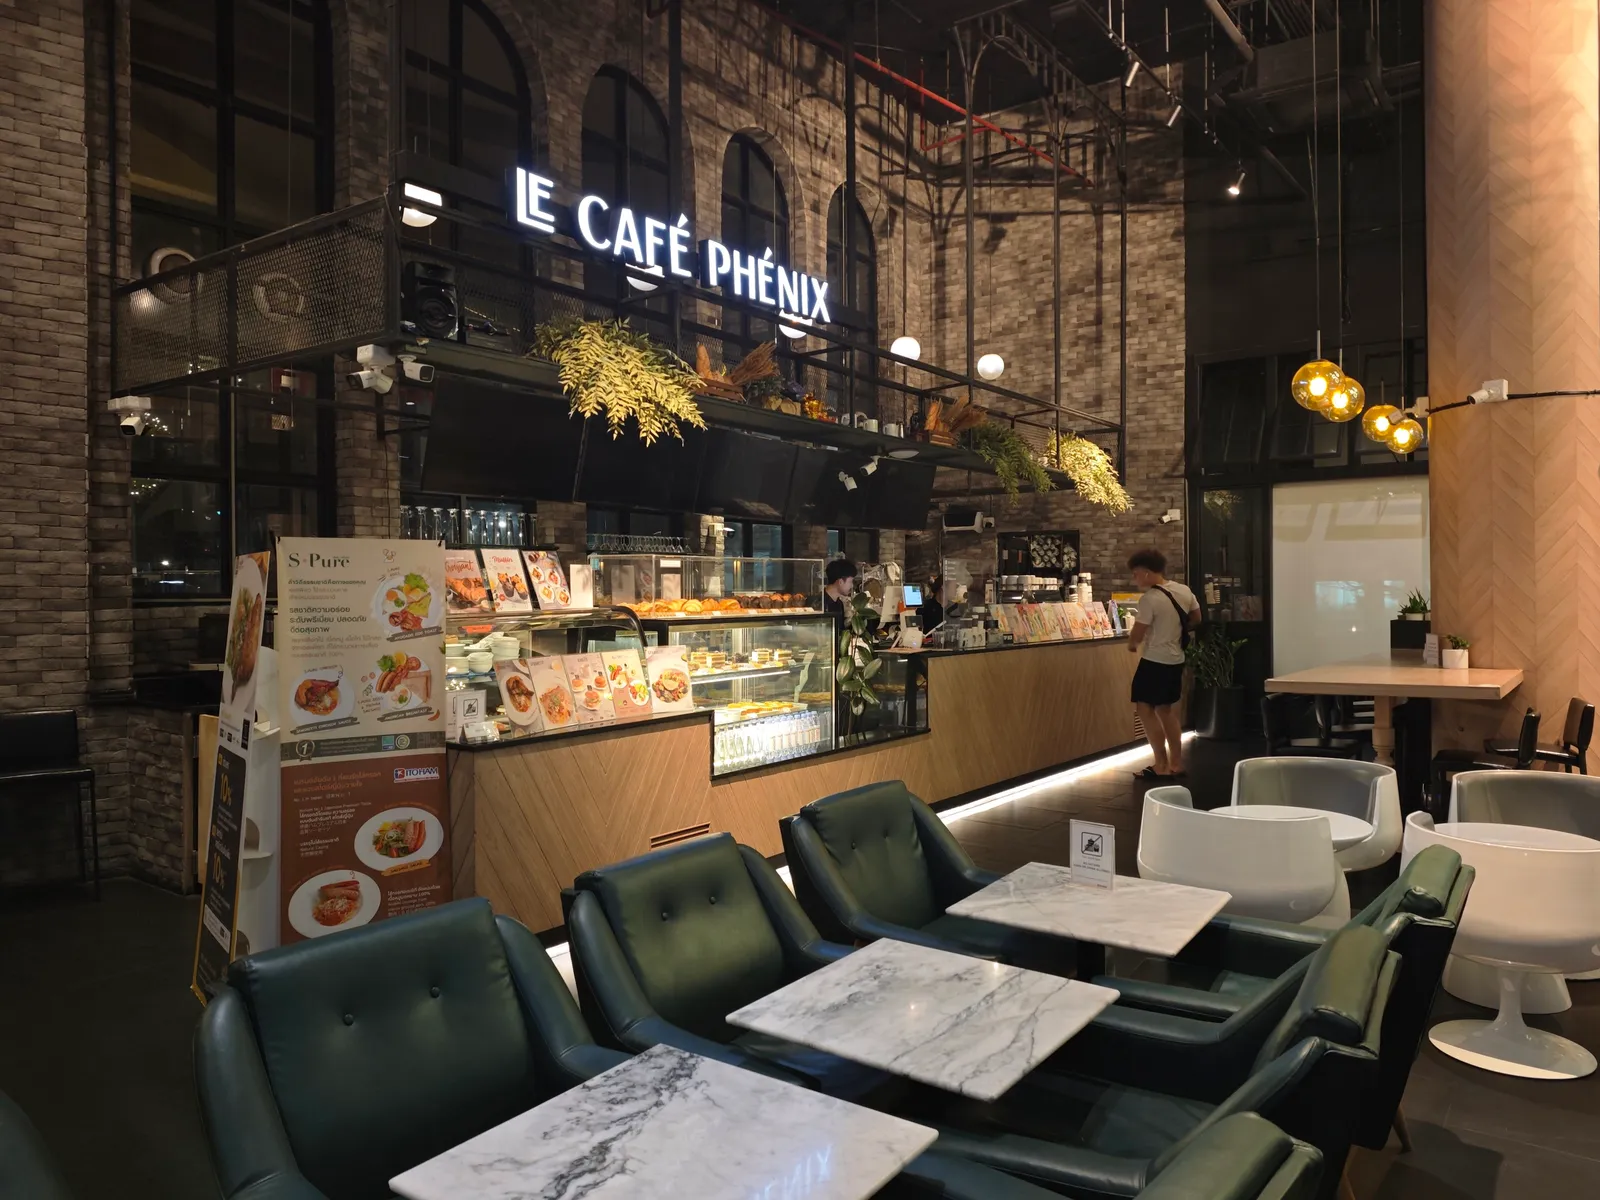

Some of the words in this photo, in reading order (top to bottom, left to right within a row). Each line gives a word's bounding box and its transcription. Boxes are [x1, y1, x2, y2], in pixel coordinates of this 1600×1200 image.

[516, 167, 555, 233] LE
[578, 195, 693, 279] CAFÉ
[708, 239, 832, 324] PHÉNIX
[289, 605, 351, 614] รสชาติความอร่อย
[337, 614, 367, 623] ปลอดภัย
[290, 624, 331, 635] ดีต่อสุขภาพ
[301, 743, 308, 756] 1
[405, 767, 438, 777] ITOHAM
